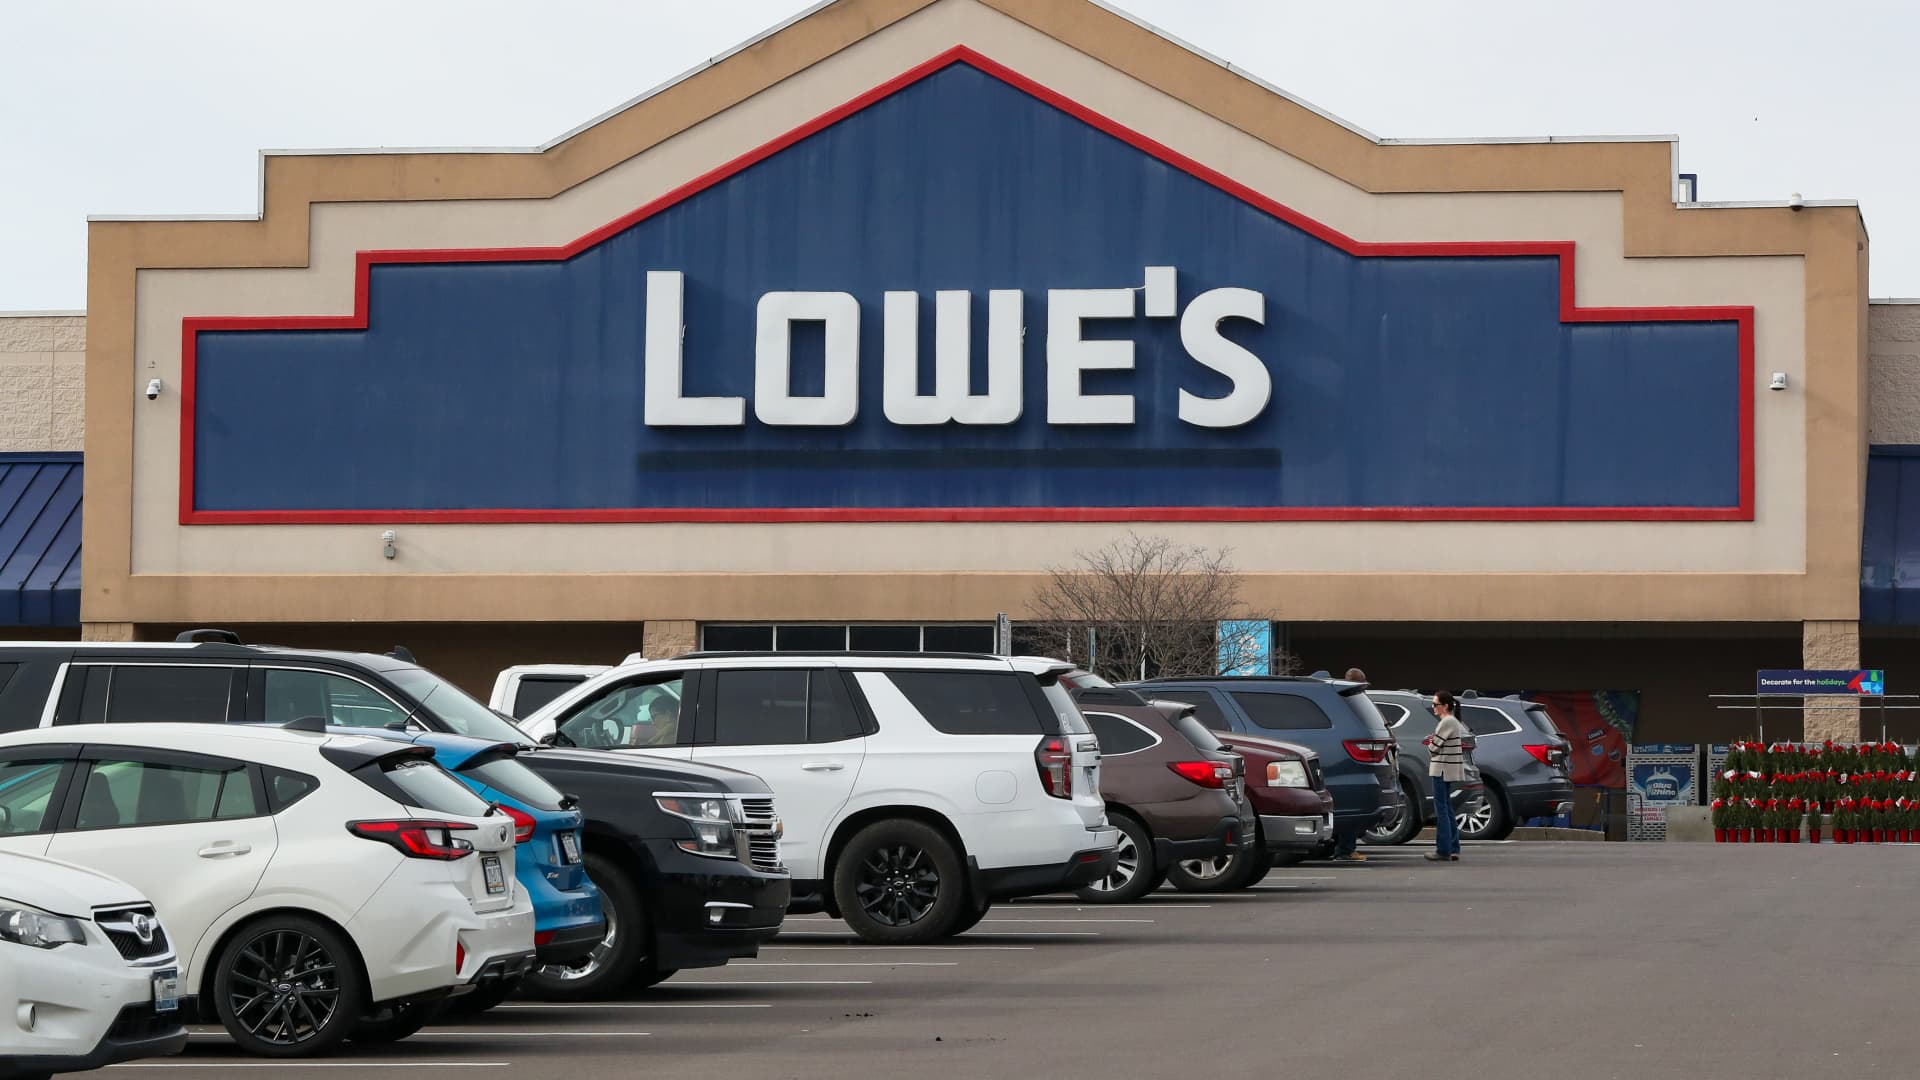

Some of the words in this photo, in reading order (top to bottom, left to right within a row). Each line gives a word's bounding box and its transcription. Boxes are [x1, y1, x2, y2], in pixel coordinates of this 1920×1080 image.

[644, 266, 1272, 428] LOWE'S
[1761, 678, 1791, 686] Decorate
[1793, 678, 1803, 686] for
[1804, 678, 1815, 686] the
[1816, 678, 1847, 687] holidays.
